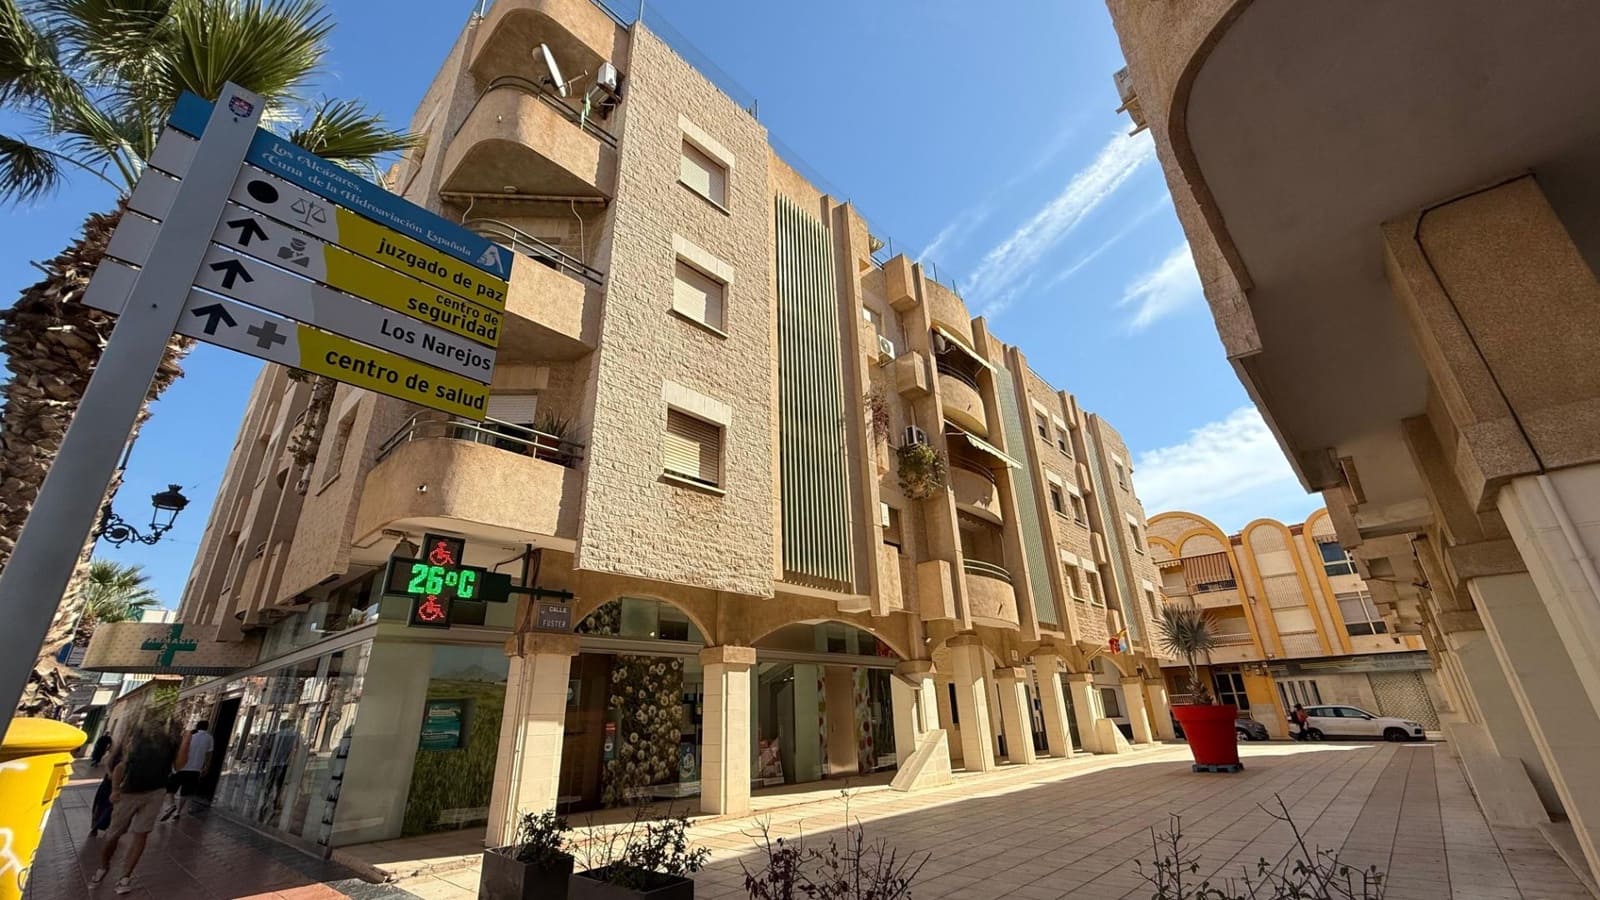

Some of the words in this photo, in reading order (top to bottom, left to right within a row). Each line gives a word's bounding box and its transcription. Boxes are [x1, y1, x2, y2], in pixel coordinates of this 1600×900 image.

[271, 142, 293, 159] Los
[262, 152, 303, 177] Cuna
[307, 174, 324, 187] de
[326, 184, 338, 194] la
[340, 188, 423, 234] Hidroaviación
[426, 229, 472, 257] Española
[376, 237, 447, 278] juzgado
[452, 271, 472, 288] de
[476, 282, 504, 302] paz
[407, 297, 498, 341] seguridad
[436, 294, 480, 318] centro
[483, 311, 499, 326] de
[380, 318, 416, 344] Los
[422, 333, 491, 371] Narejos
[325, 351, 399, 384] centro
[405, 374, 430, 393] de
[435, 384, 486, 410] salud
[549, 606, 568, 614] CALLE
